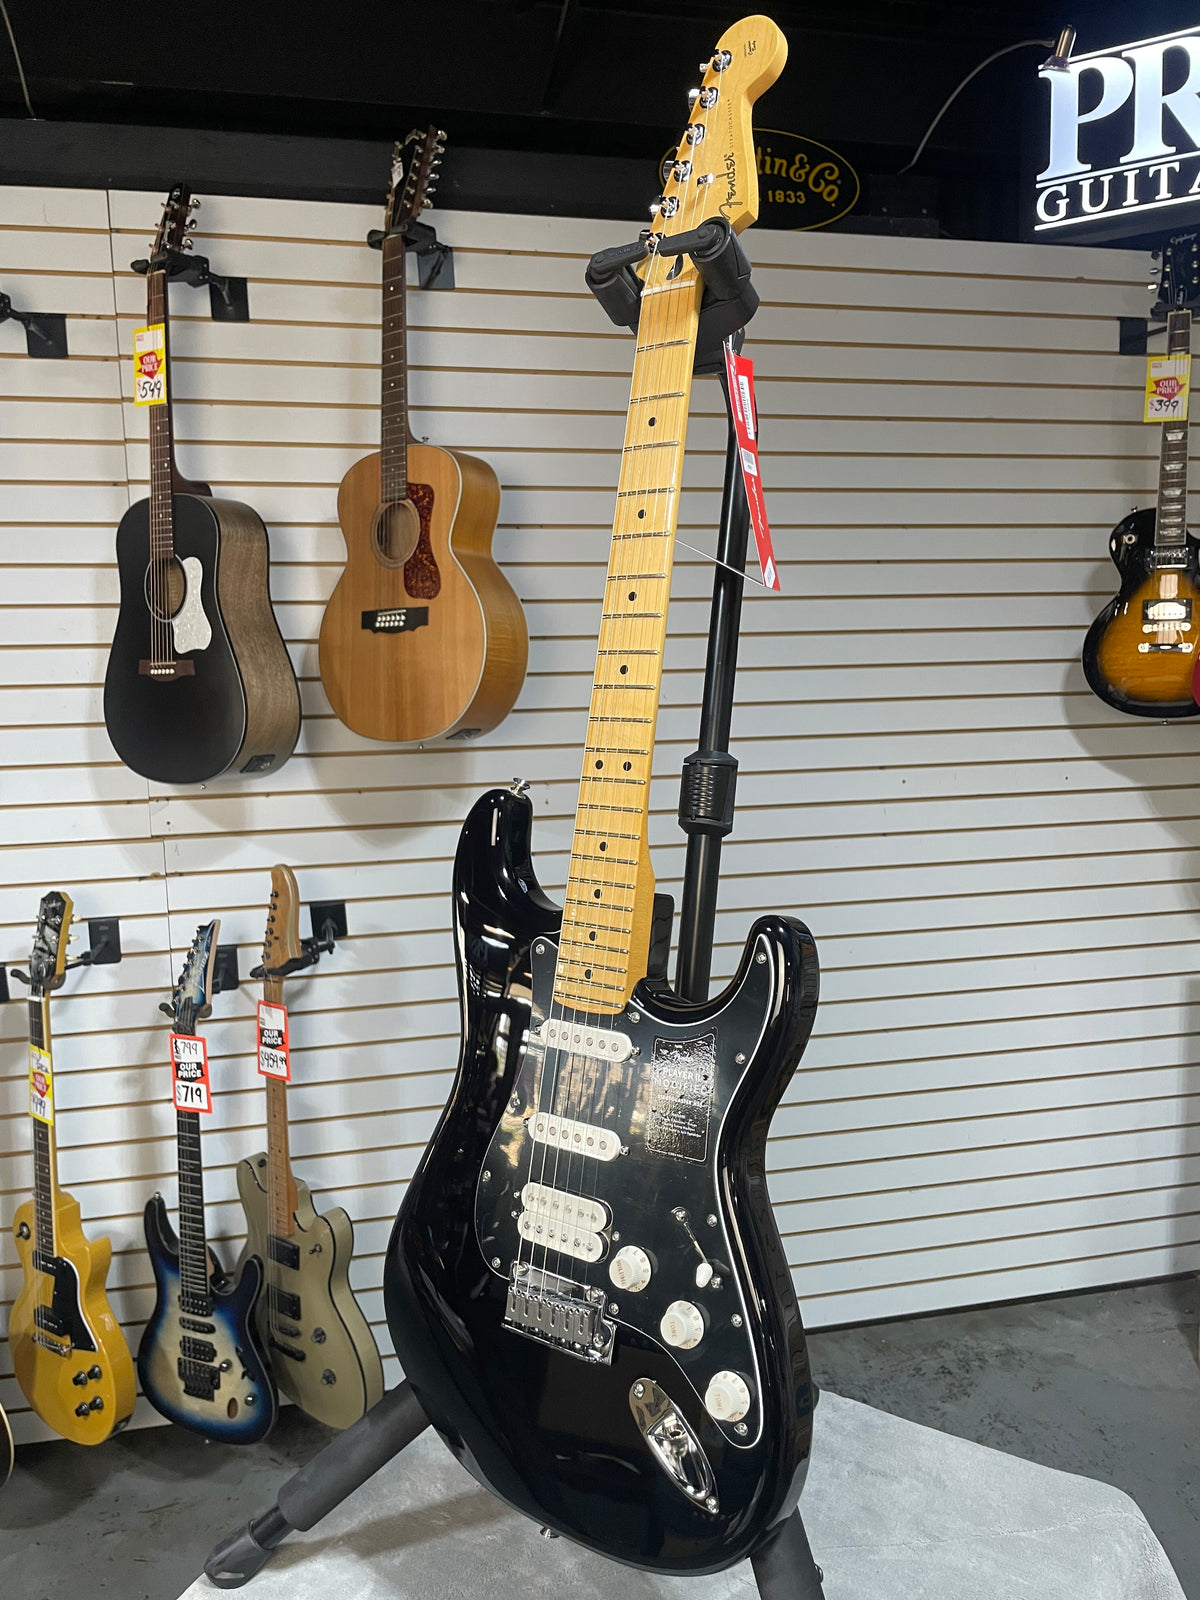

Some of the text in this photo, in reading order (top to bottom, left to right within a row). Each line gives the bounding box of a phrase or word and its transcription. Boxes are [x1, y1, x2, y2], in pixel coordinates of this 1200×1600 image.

[1036, 36, 1200, 181] PR
[716, 152, 743, 220] Fender
[768, 190, 806, 204] 1833
[142, 354, 157, 364] OUR
[141, 362, 158, 373] PRICE
[1159, 380, 1178, 388] OUR
[1156, 386, 1180, 394] PRICE
[1149, 399, 1179, 412] $399
[263, 1029, 279, 1037] OUR
[261, 1036, 283, 1045] PRICE
[180, 1063, 198, 1071] OUR
[178, 1070, 202, 1078] PRICE
[663, 1067, 693, 1081] PLAYER
[176, 1085, 203, 1103] $719
